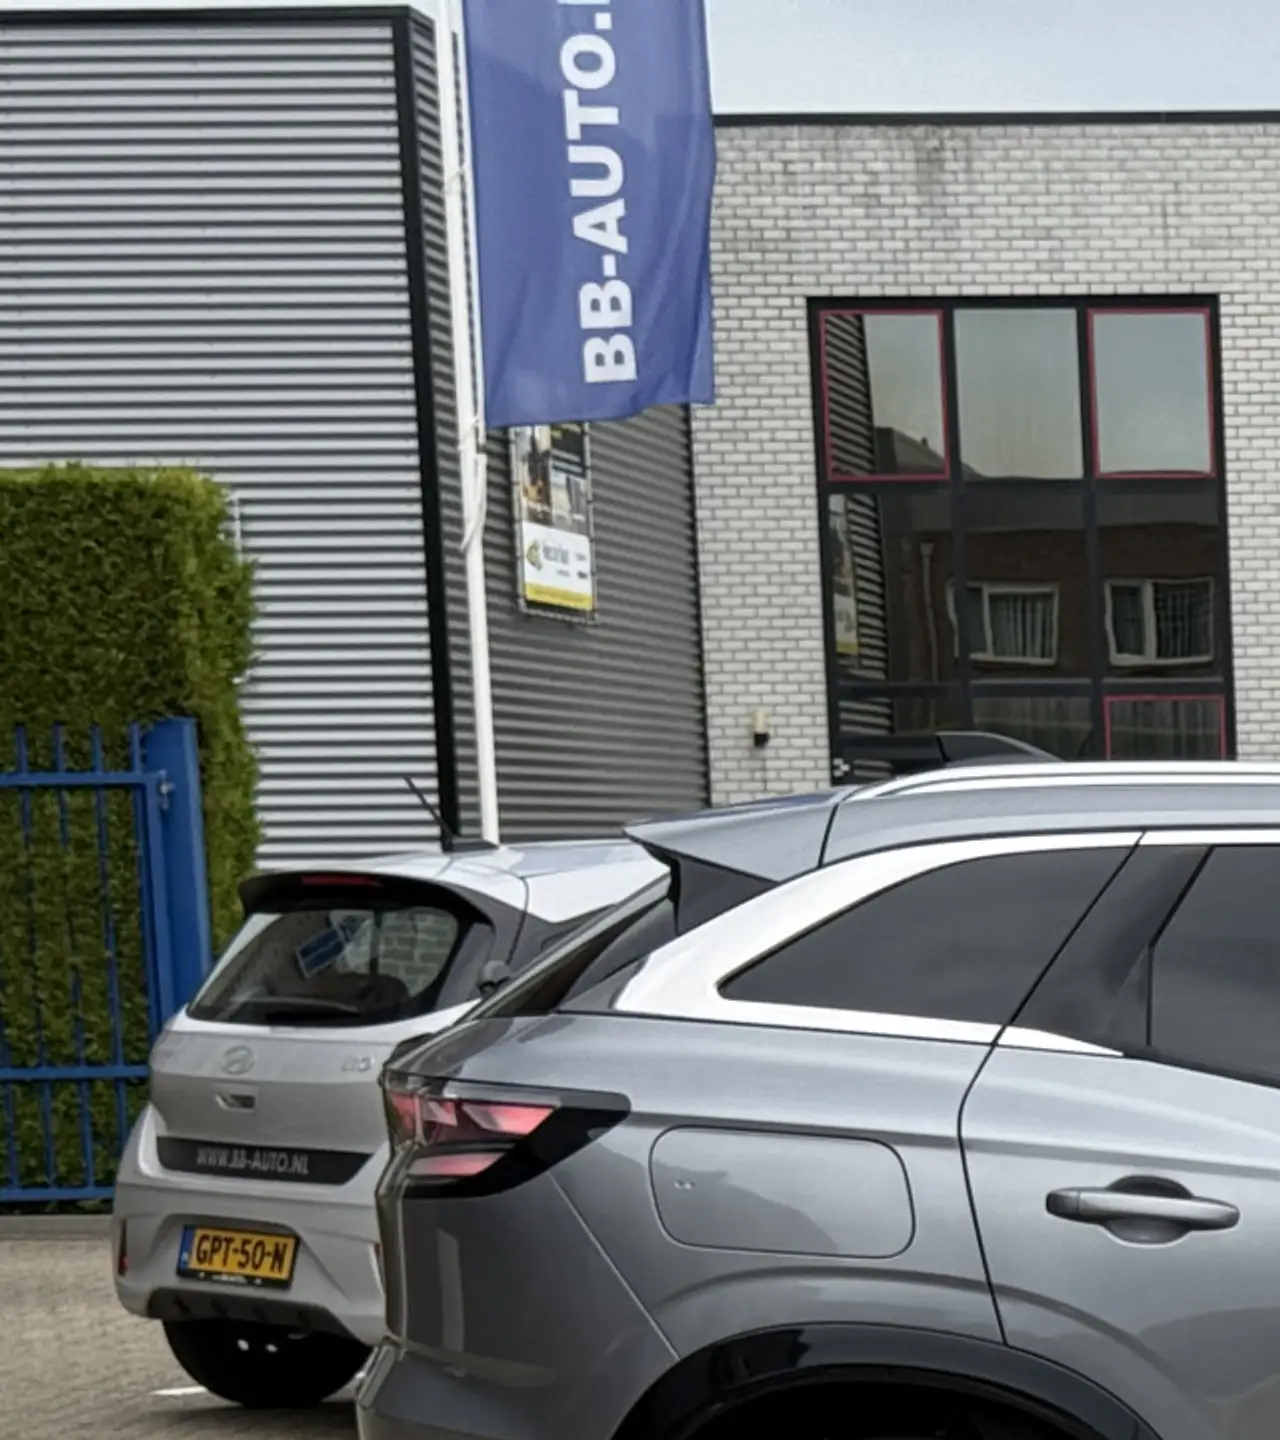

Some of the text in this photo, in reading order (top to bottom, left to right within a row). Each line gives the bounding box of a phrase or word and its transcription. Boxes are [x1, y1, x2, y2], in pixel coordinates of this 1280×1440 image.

[556, 0, 638, 384] BB-AUTO.
[196, 1147, 311, 1176] WWW.BB-AUTO.NL
[196, 1233, 289, 1274] GPT-50-N
